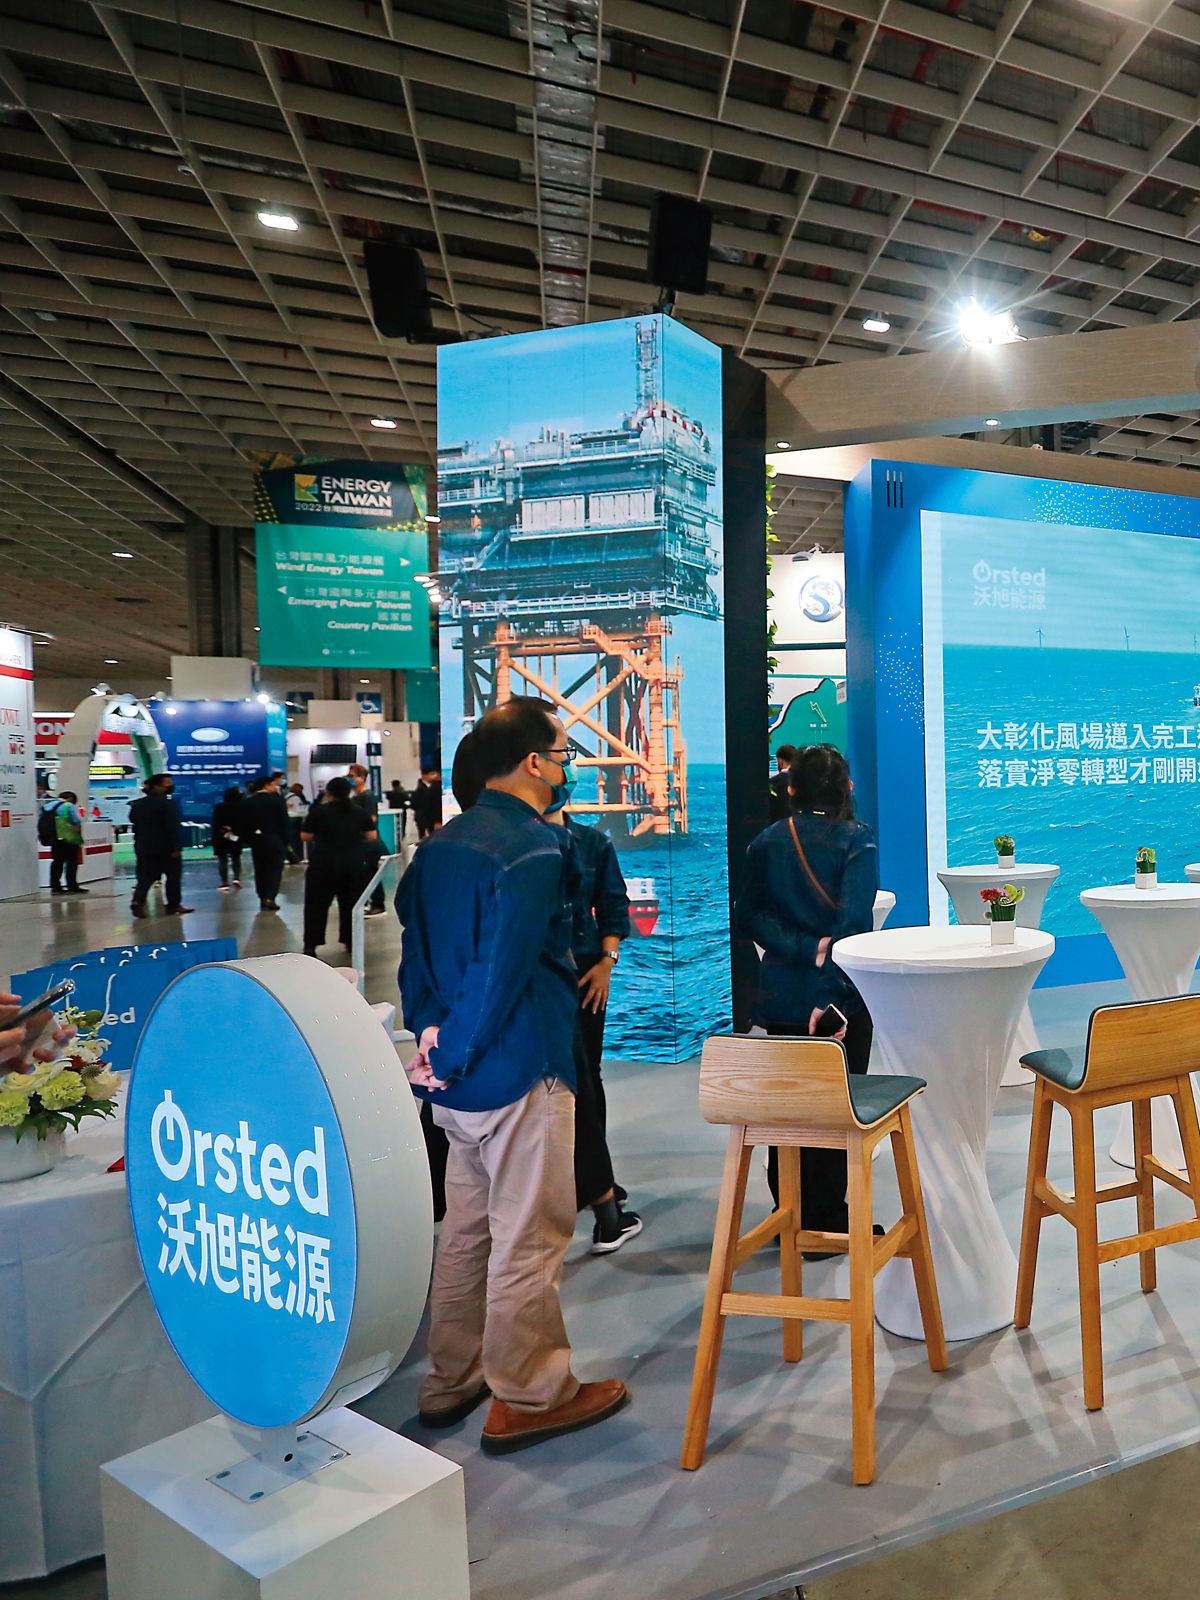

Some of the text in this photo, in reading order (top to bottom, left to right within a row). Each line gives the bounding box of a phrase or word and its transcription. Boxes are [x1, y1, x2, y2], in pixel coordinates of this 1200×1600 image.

[321, 476, 392, 494] ENERGY
[321, 490, 392, 508] TAIWAN
[275, 562, 384, 576] Wind Energy Taiwan
[287, 596, 412, 610] Emerging Power Taiwan
[972, 586, 1046, 611] 沃旭能源
[327, 620, 413, 632] Country Pavilion
[156, 1192, 336, 1325] 沃旭能源
